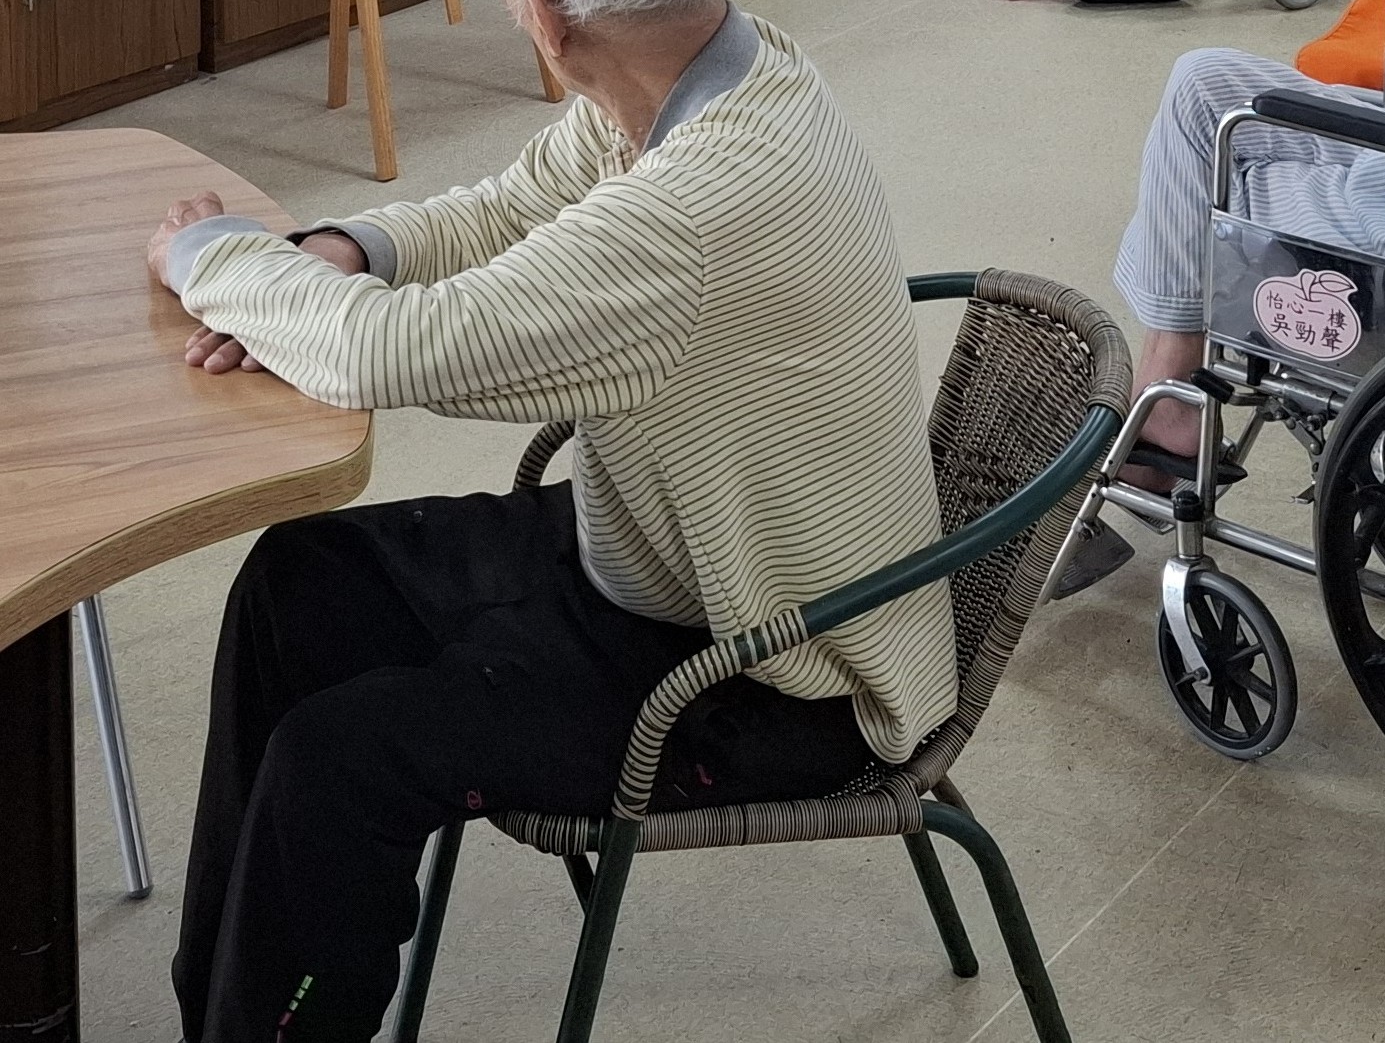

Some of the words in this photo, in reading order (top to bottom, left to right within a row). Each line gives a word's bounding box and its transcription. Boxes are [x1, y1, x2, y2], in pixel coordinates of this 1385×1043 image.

[1266, 290, 1348, 330] 怡心一樓
[1270, 313, 1343, 352] 吳勁聲
